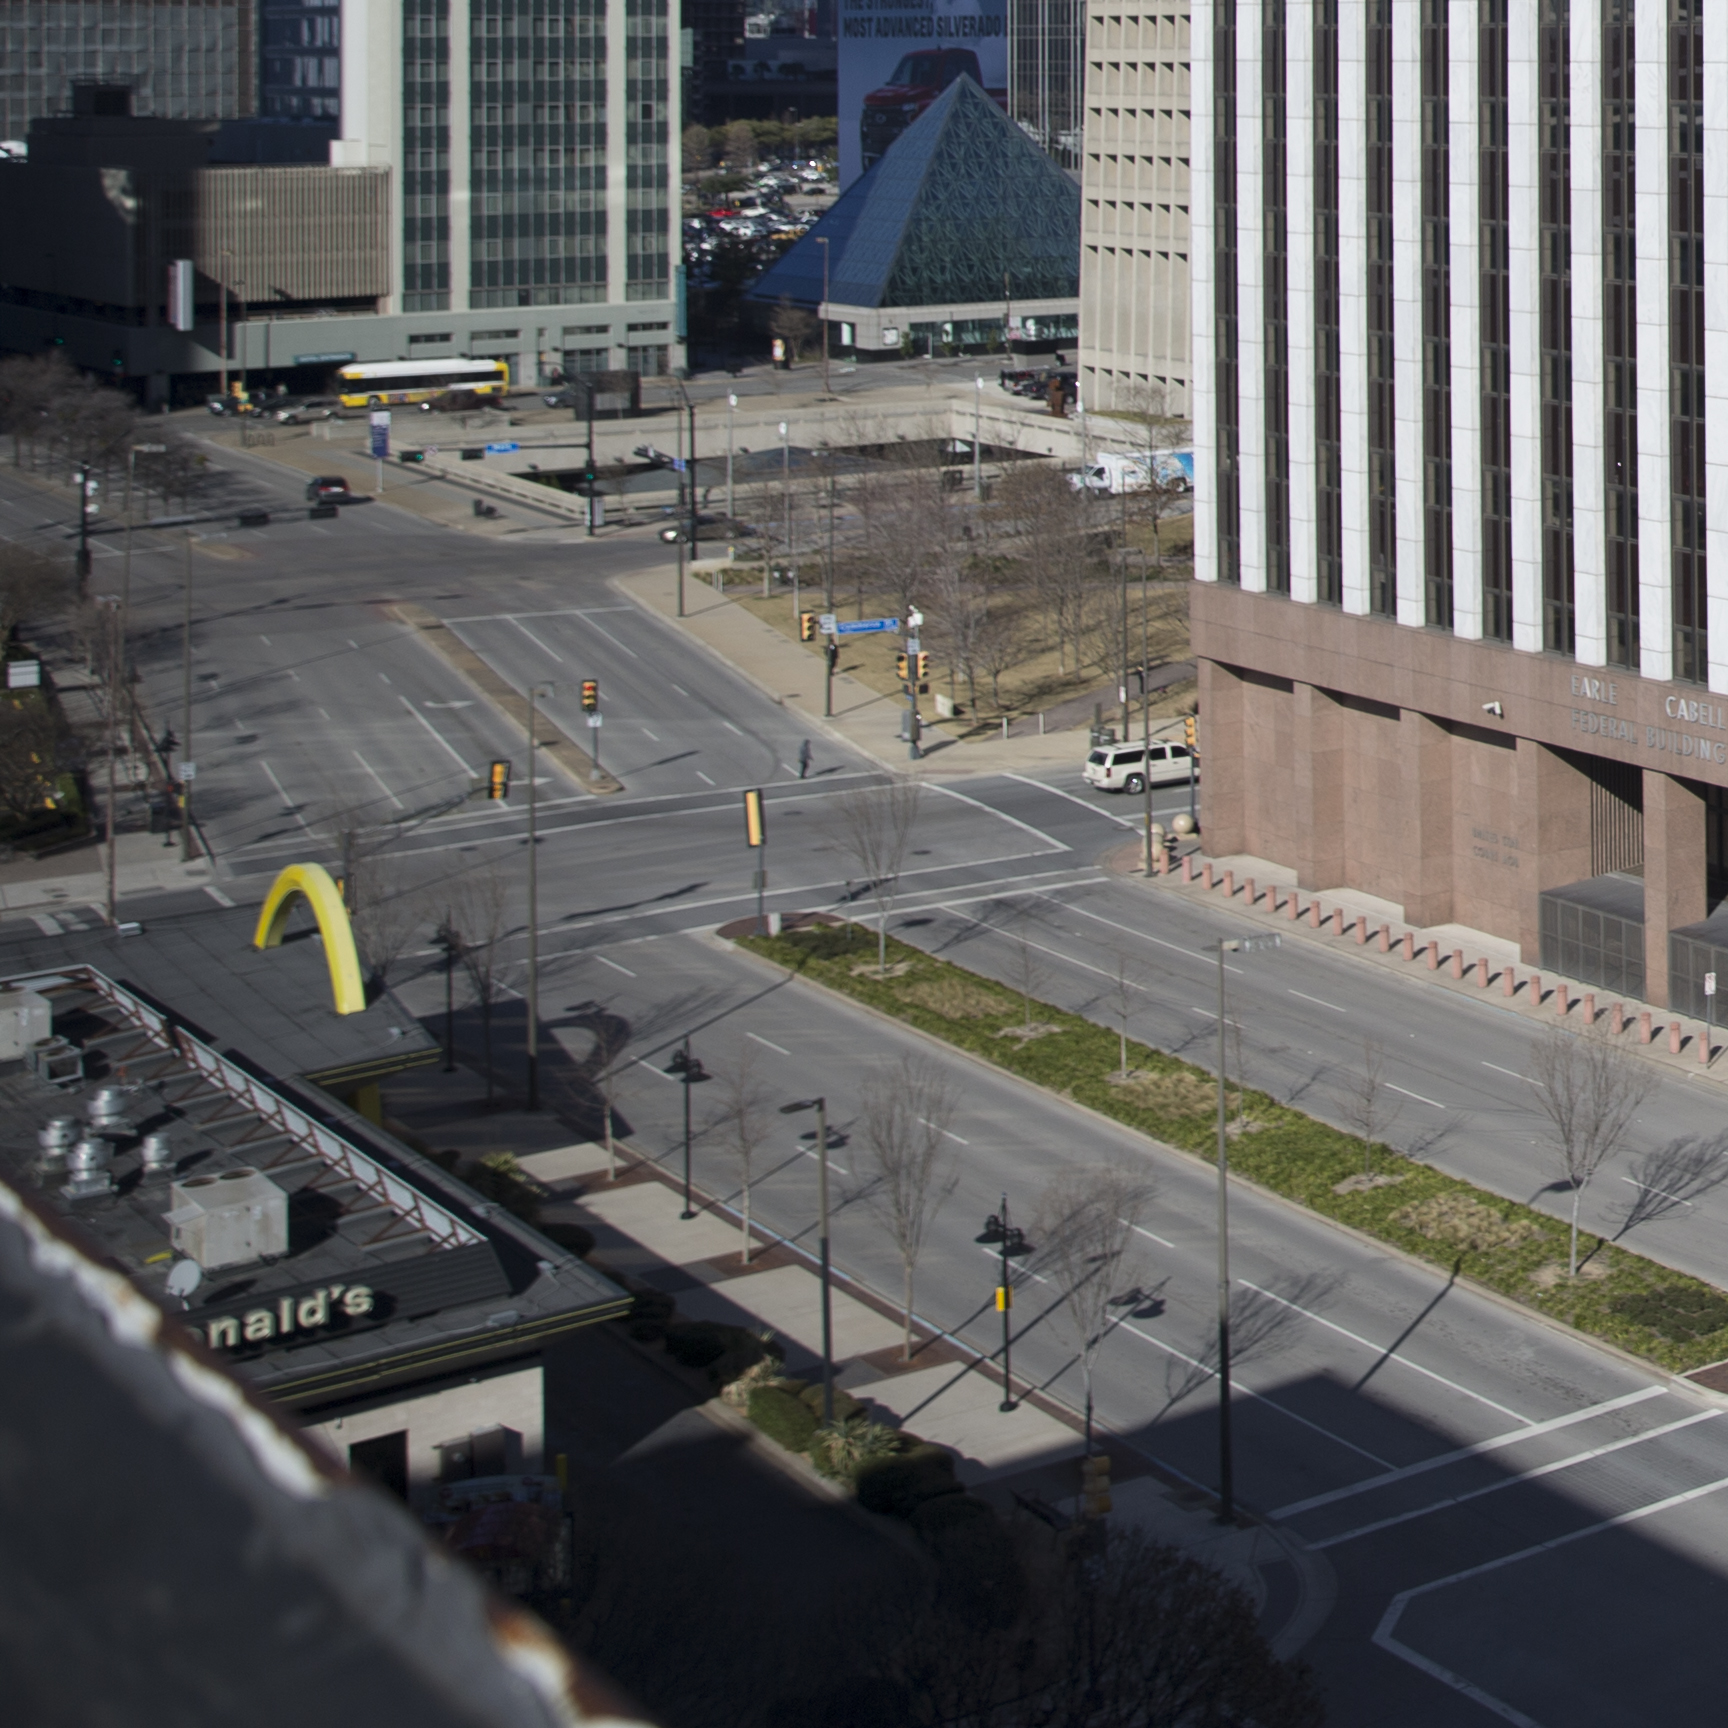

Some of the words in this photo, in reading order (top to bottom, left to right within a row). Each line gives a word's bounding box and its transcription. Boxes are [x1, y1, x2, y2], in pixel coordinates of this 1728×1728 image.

[843, 17, 873, 38] MOST
[875, 15, 933, 37] ADVANCED
[935, 14, 1001, 37] SILVERADO
[1571, 674, 1618, 705] EARLE
[1665, 696, 1727, 730] CABELL
[1571, 709, 1638, 744] FEDERAL
[1646, 725, 1727, 764] BUILDING
